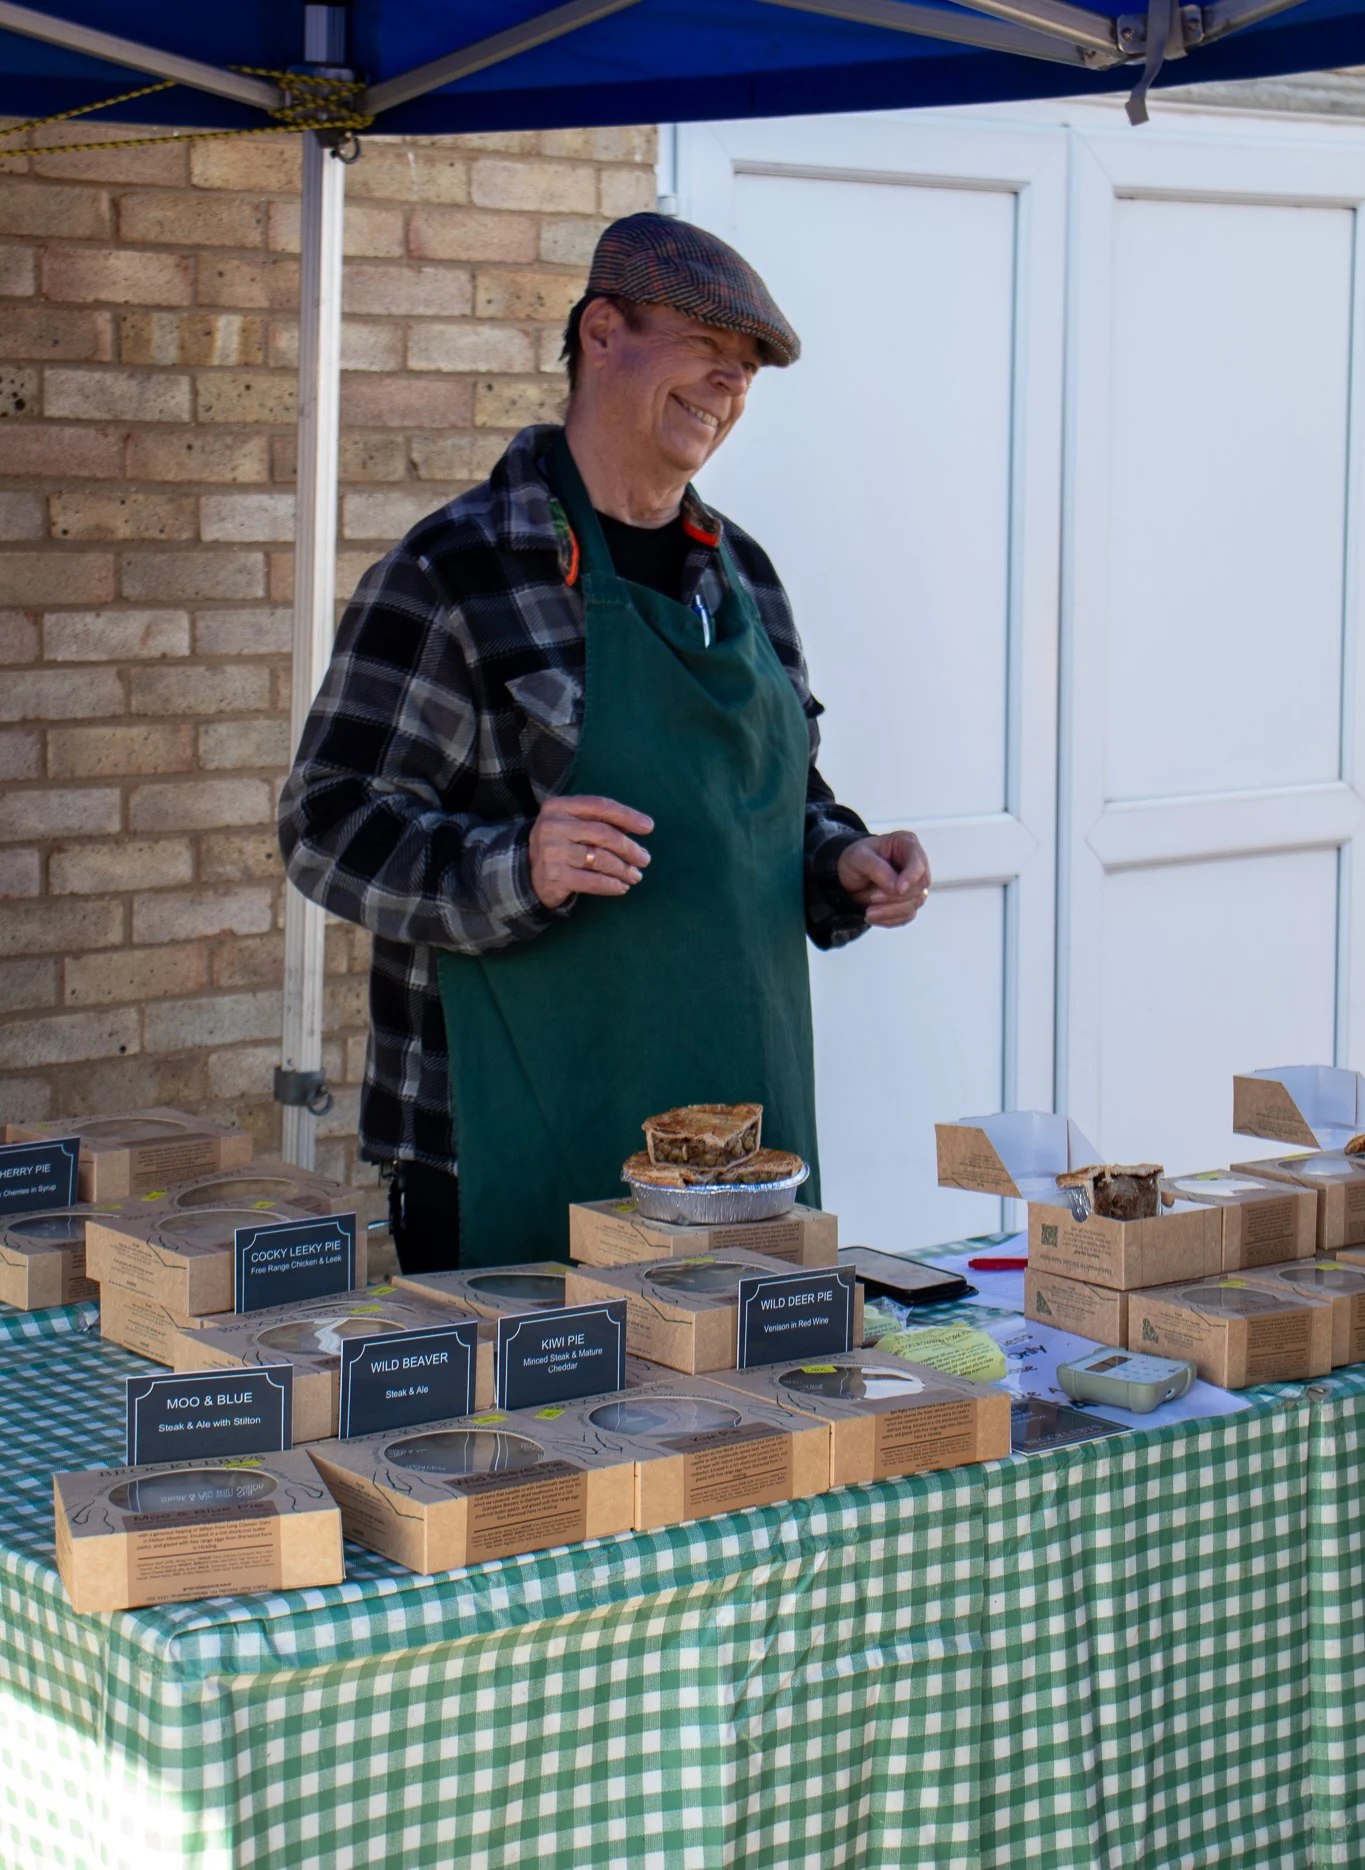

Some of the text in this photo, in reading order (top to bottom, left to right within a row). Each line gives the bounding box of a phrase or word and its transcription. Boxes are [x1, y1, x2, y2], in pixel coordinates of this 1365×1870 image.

[0, 1163, 51, 1179] HERRY PIE
[3, 1187, 30, 1197] Cherries
[38, 1184, 57, 1194] Syrup
[251, 1240, 341, 1263] COCKY LEEKY PIE
[250, 1267, 267, 1275] Free
[267, 1263, 290, 1273] Range
[291, 1259, 318, 1269] Chicken
[325, 1254, 342, 1264] Leek
[760, 1290, 833, 1311] WILD DEER PIE
[763, 1317, 829, 1333] Venison in Red Wine
[541, 1333, 585, 1351] KIWI PIE
[370, 1352, 449, 1374] WILD BEAVER
[523, 1347, 603, 1367] Minced Steak & Mature
[547, 1361, 578, 1374] Cheddar
[166, 1391, 253, 1410] MOO & BLUE
[385, 1385, 429, 1399] Steak & Ale
[158, 1416, 261, 1433] Steak & Ale with Stilton
